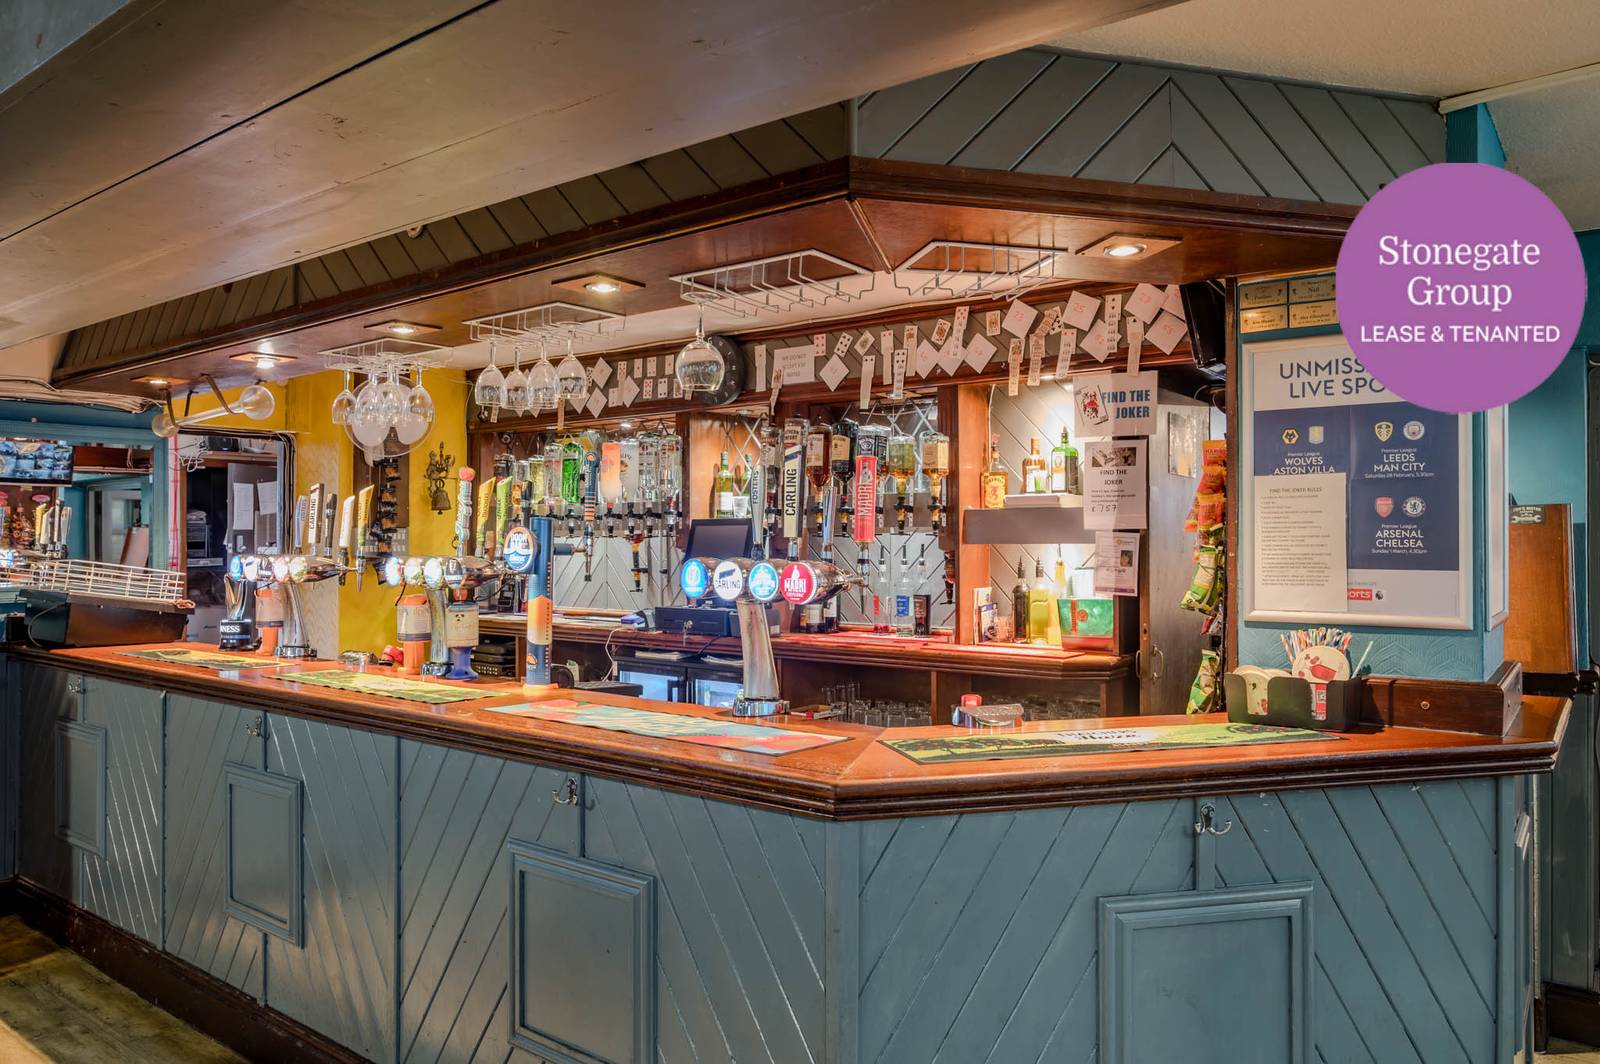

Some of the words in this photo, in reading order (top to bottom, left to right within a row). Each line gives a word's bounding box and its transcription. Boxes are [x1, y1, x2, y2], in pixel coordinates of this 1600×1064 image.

[1280, 357, 1369, 379] UNMISS
[1290, 380, 1335, 398] LIVE
[1102, 391, 1126, 403] FIND
[1129, 390, 1151, 402] THE
[1115, 406, 1150, 419] JOKER
[1284, 456, 1324, 466] WOLVES
[1383, 453, 1416, 463] LEEDS
[1274, 466, 1306, 475] ASTON
[1307, 465, 1336, 474] VILLA
[1373, 464, 1399, 473] MAN
[1401, 462, 1426, 472] CITY
[785, 468, 797, 516] CARLING
[1375, 529, 1424, 538] ARSENAL
[1375, 539, 1424, 548] CHELSEA
